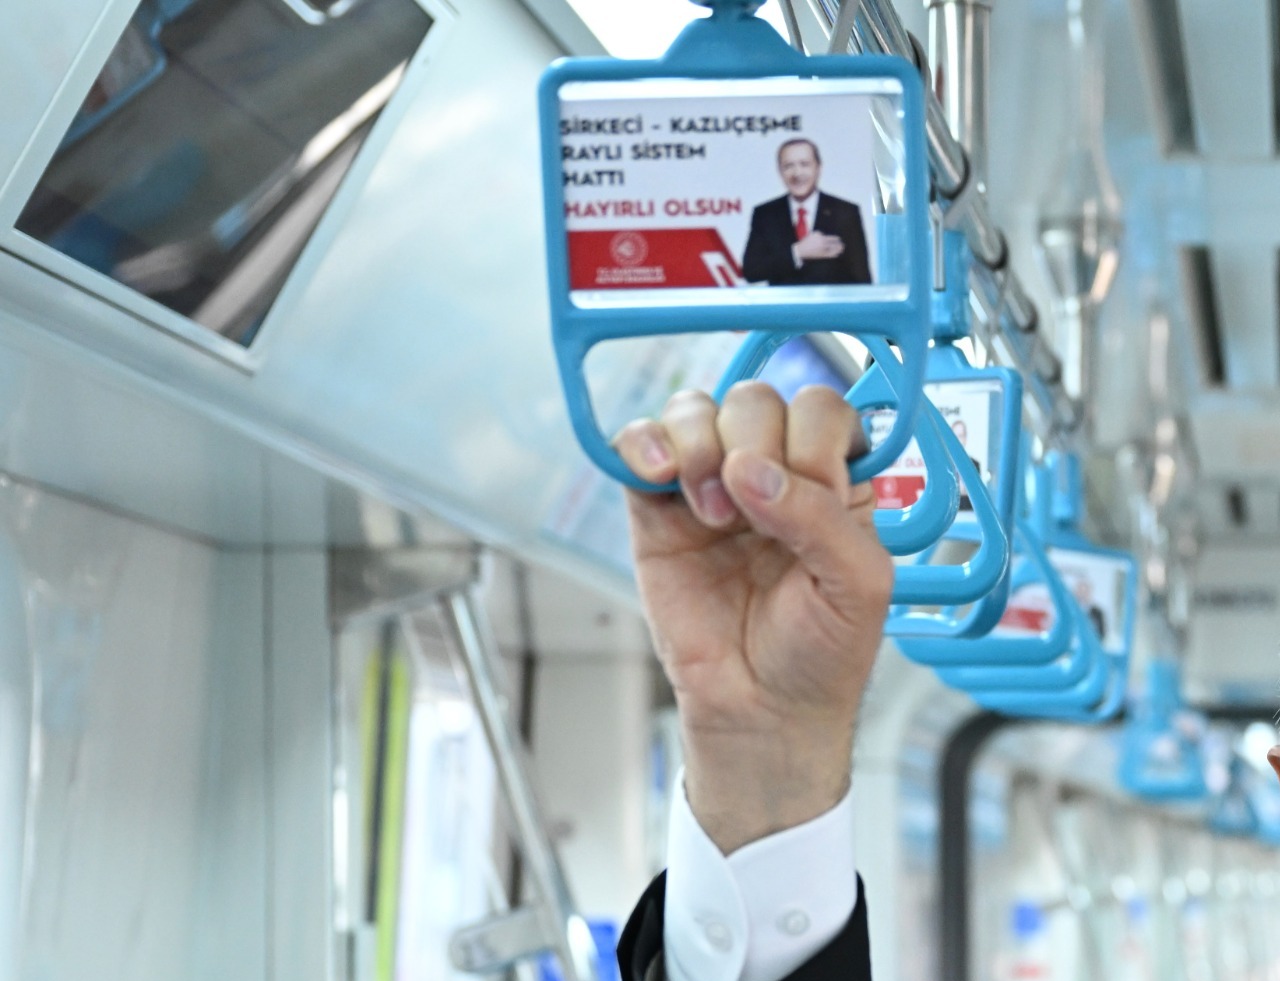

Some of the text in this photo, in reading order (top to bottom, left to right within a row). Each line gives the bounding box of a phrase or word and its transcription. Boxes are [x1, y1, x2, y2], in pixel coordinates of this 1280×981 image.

[560, 114, 643, 136] SİRKECİ
[670, 114, 803, 136] KAZLIÇEŞME
[562, 140, 706, 161] RAYLI SİSTEM
[562, 169, 624, 187] HATTI
[564, 198, 743, 218] HAYIRLI OLSUN
